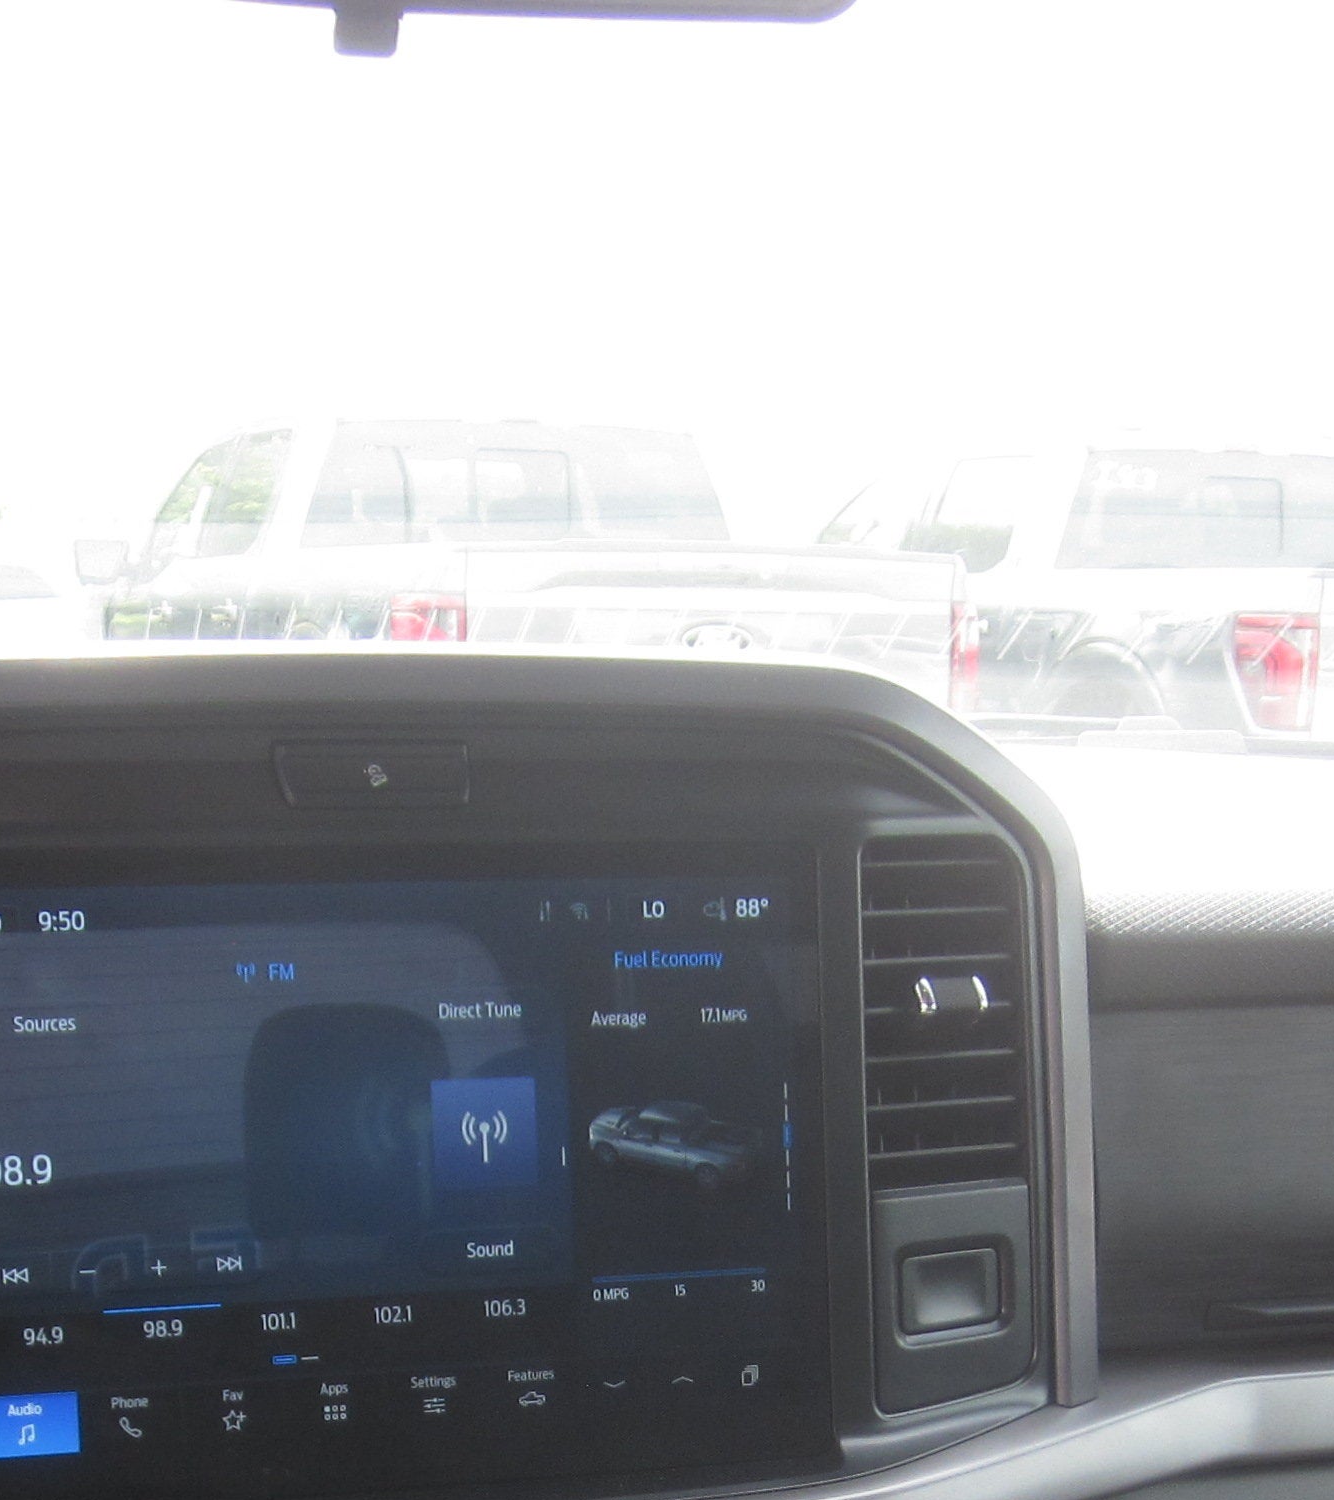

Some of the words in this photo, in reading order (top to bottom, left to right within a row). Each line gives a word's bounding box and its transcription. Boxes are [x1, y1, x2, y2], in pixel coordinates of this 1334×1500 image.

[642, 900, 666, 919] LO
[37, 910, 86, 931] 9:50
[614, 951, 648, 968] Fuel
[651, 950, 724, 969] Economy
[268, 963, 295, 981] FM
[438, 1002, 482, 1019] Direct
[485, 1001, 522, 1018] Tune
[590, 1010, 647, 1028] Average
[13, 1015, 77, 1033] Sources
[466, 1240, 514, 1258] Sound
[593, 1289, 602, 1301] 0
[603, 1287, 629, 1301] MPG
[674, 1284, 686, 1297] 15
[751, 1279, 766, 1293] 30
[373, 1305, 413, 1325] 102.1
[483, 1299, 526, 1318] 106.3
[143, 1318, 183, 1339] 98.9
[260, 1311, 297, 1331] 101.1
[23, 1325, 64, 1346] 94.9
[410, 1373, 457, 1390] Settings
[507, 1368, 555, 1382] Features
[222, 1388, 245, 1402] Fav
[319, 1381, 349, 1397] Apps
[6, 1402, 43, 1417] Audio
[110, 1394, 149, 1410] Phone
